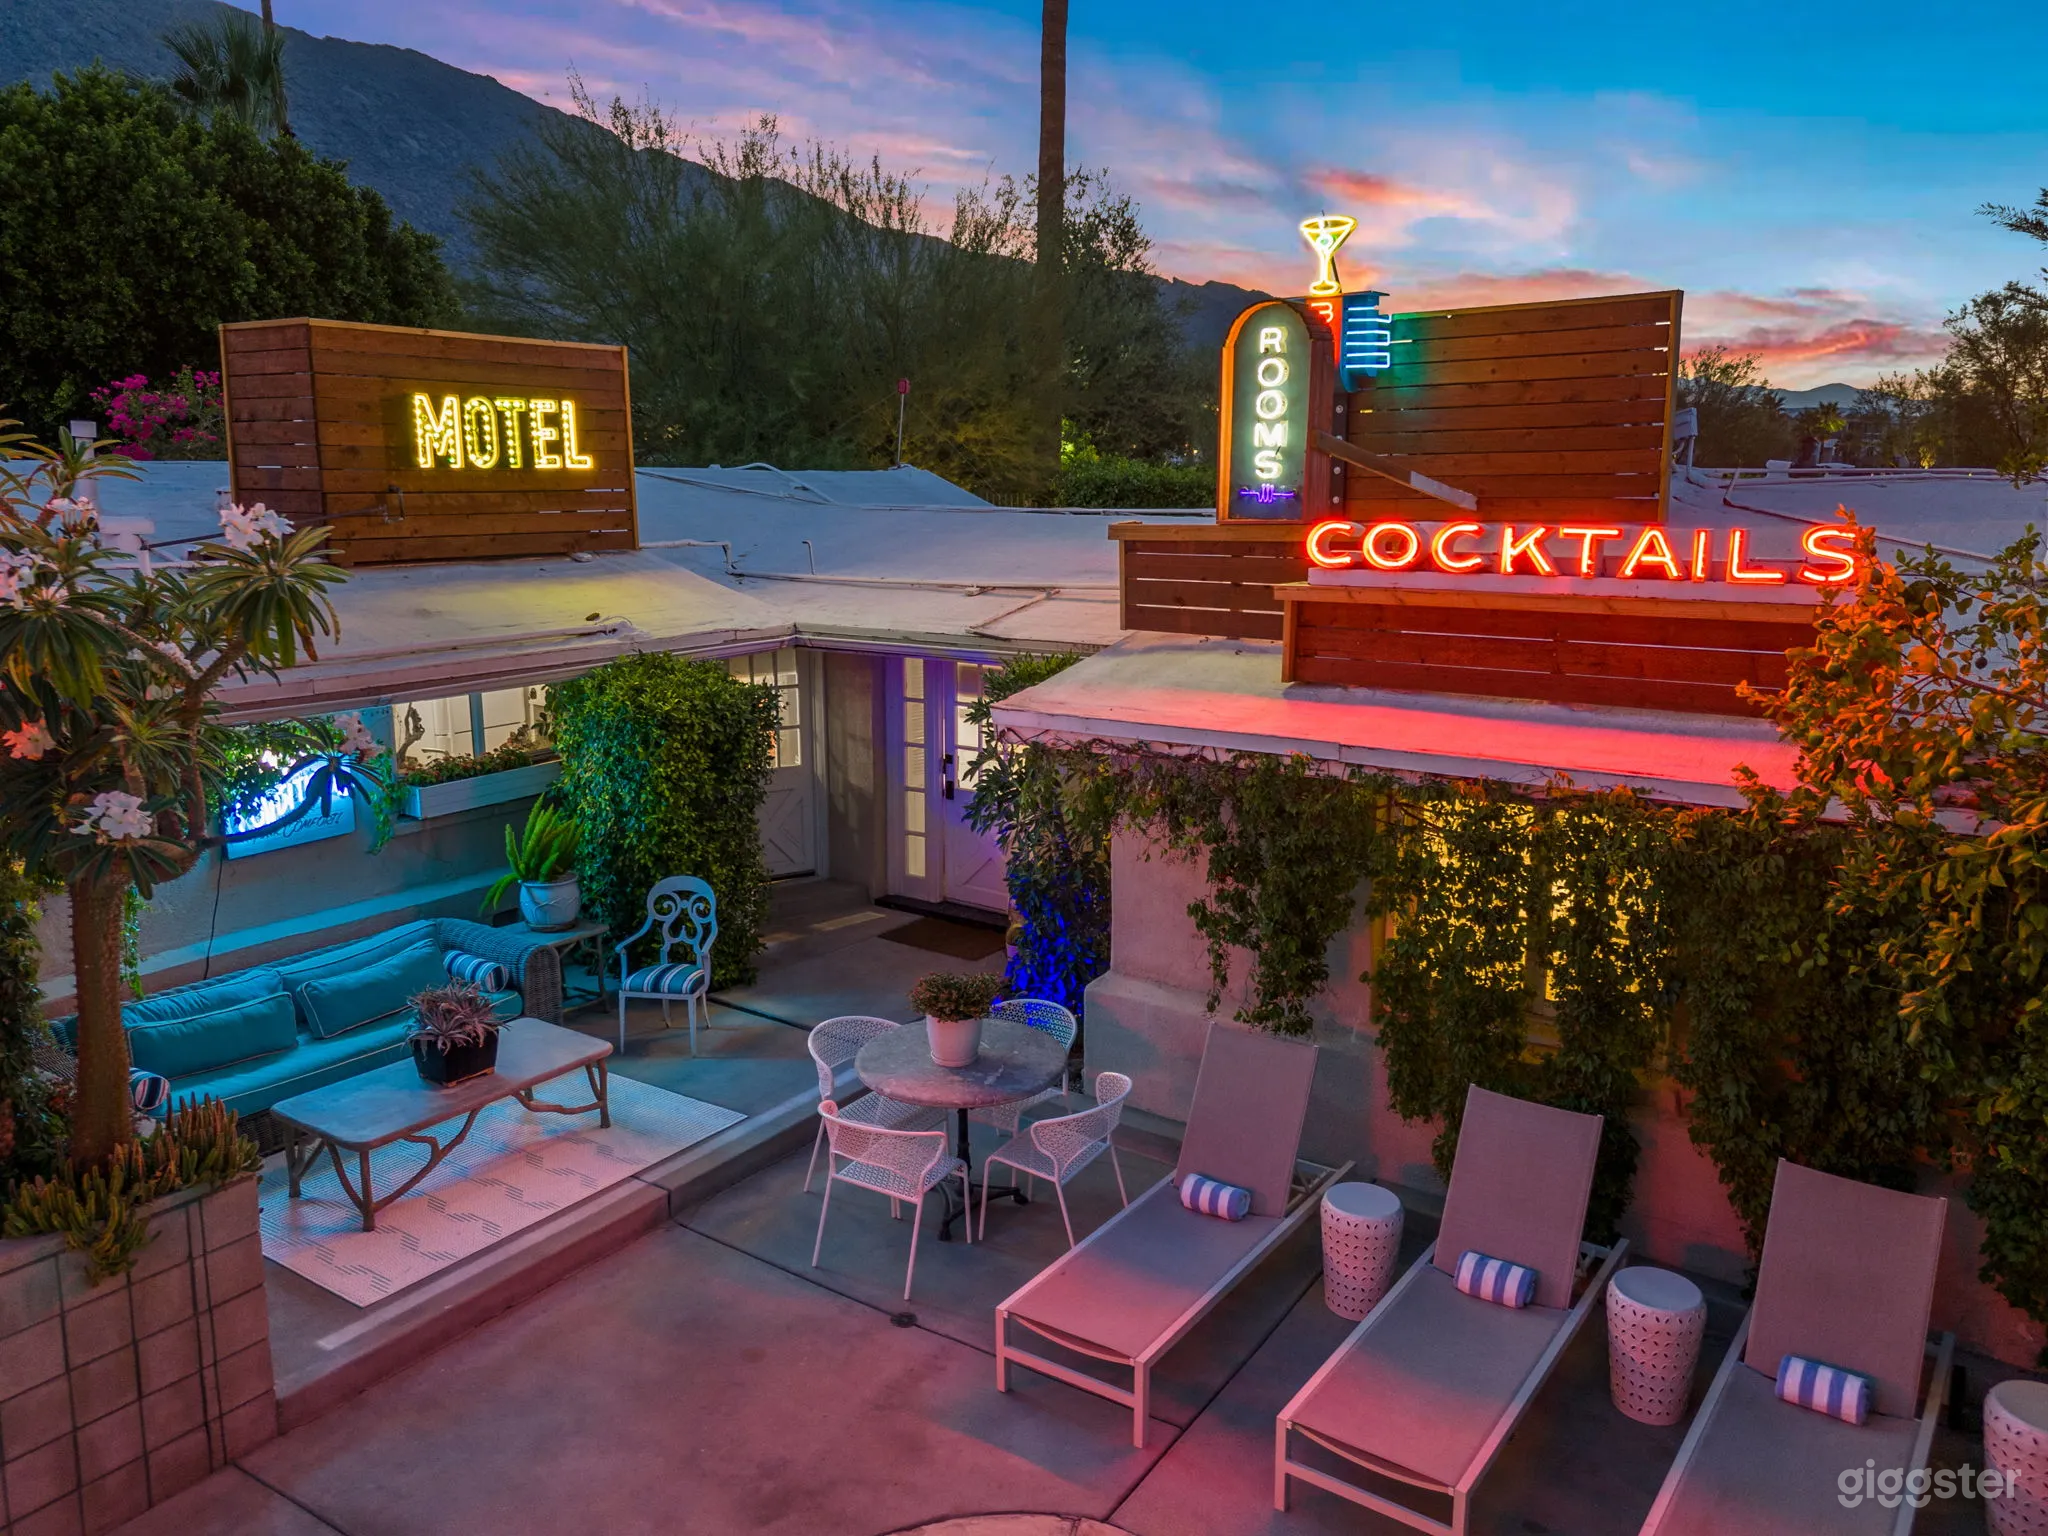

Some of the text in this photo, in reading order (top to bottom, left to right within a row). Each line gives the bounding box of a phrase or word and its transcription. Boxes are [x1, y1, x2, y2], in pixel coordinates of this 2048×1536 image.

[414, 392, 593, 468] MOTEL
[1254, 327, 1287, 479] ROOMS
[1305, 520, 1859, 586] COCKTAILS
